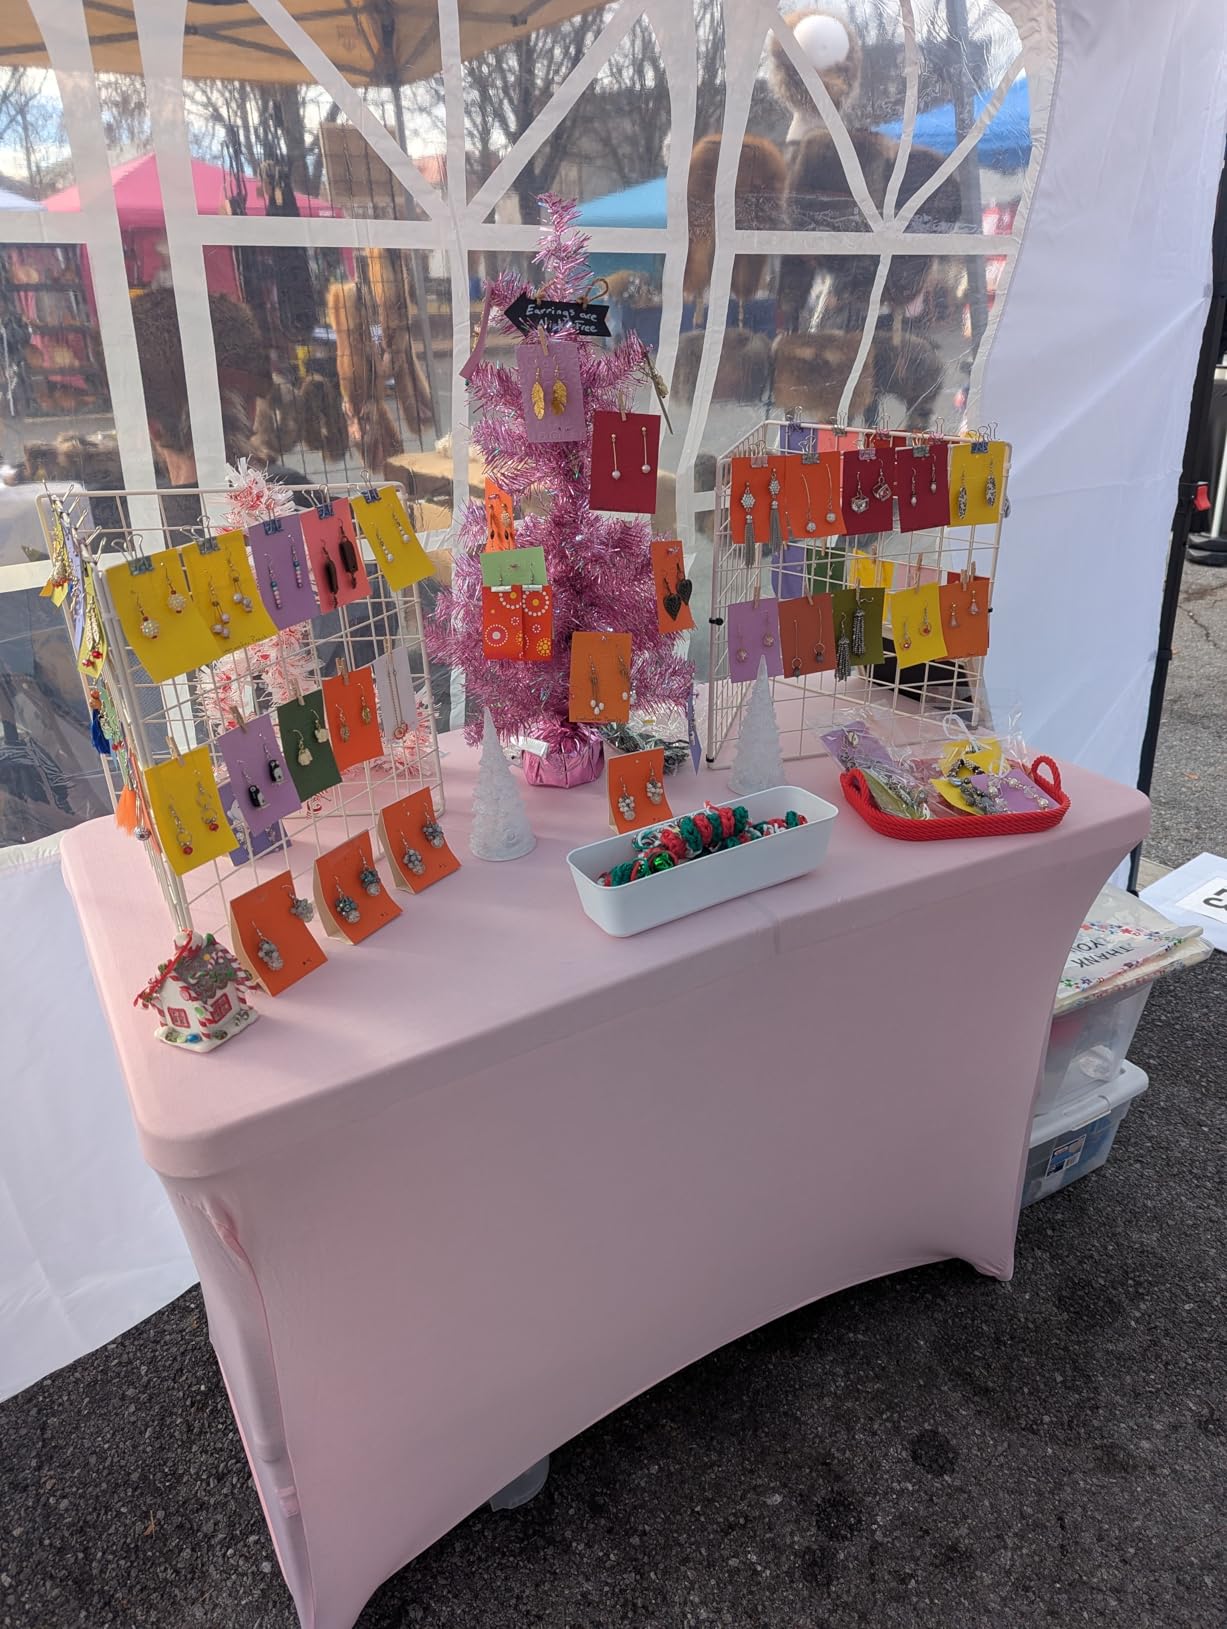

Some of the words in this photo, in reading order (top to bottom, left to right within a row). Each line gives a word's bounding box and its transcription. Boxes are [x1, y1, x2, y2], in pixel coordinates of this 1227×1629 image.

[526, 304, 575, 322] Earrings
[579, 312, 597, 322] are
[1071, 945, 1135, 968] THANK
